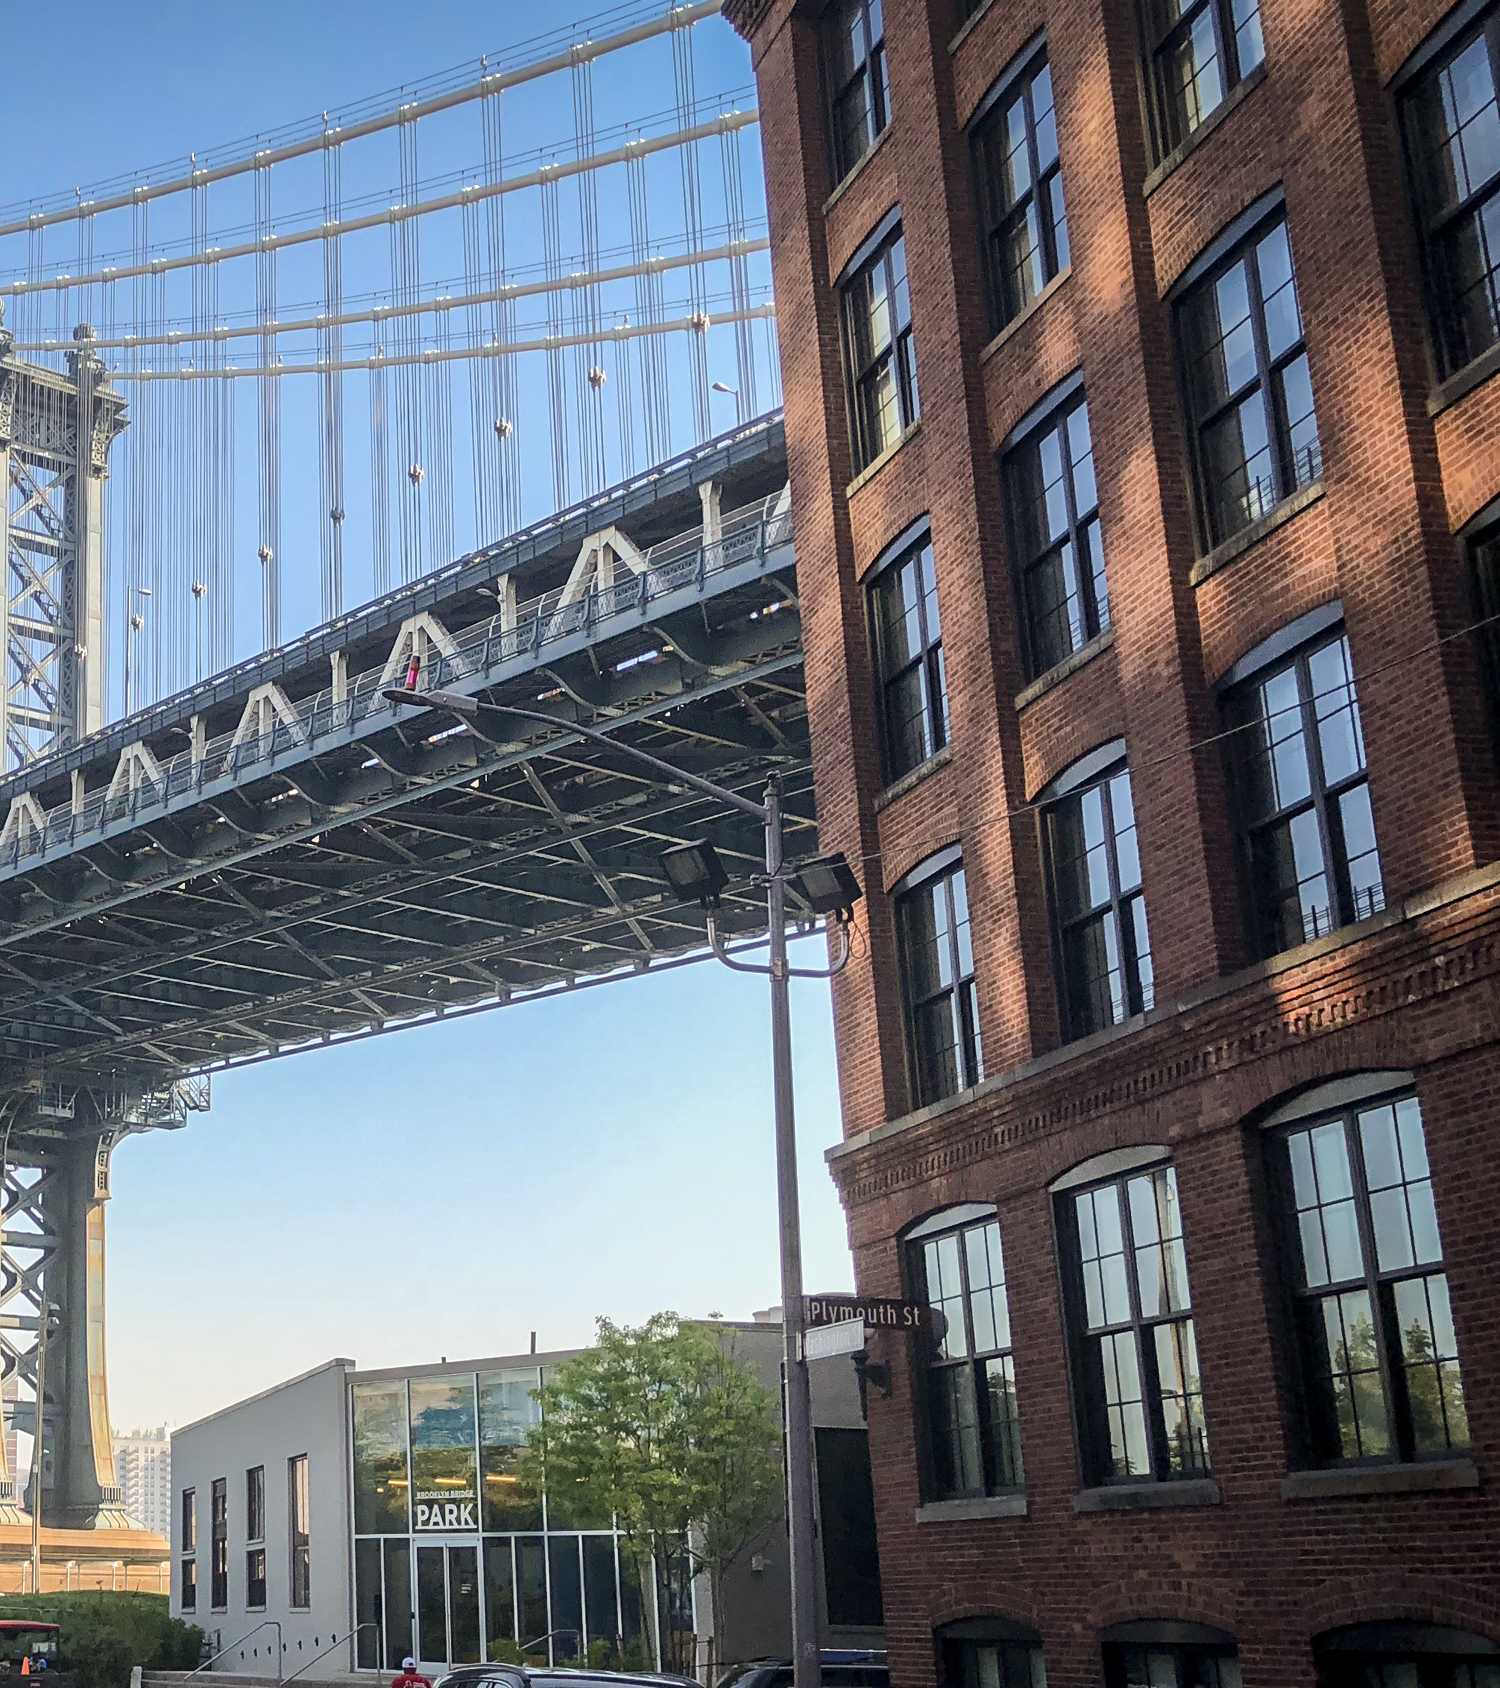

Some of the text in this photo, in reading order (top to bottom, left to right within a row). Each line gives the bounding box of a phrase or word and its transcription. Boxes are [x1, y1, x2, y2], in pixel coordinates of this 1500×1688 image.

[811, 1301, 920, 1326] Plymouth St
[451, 1489, 474, 1497] BRIDGE
[417, 1503, 475, 1527] PARK
